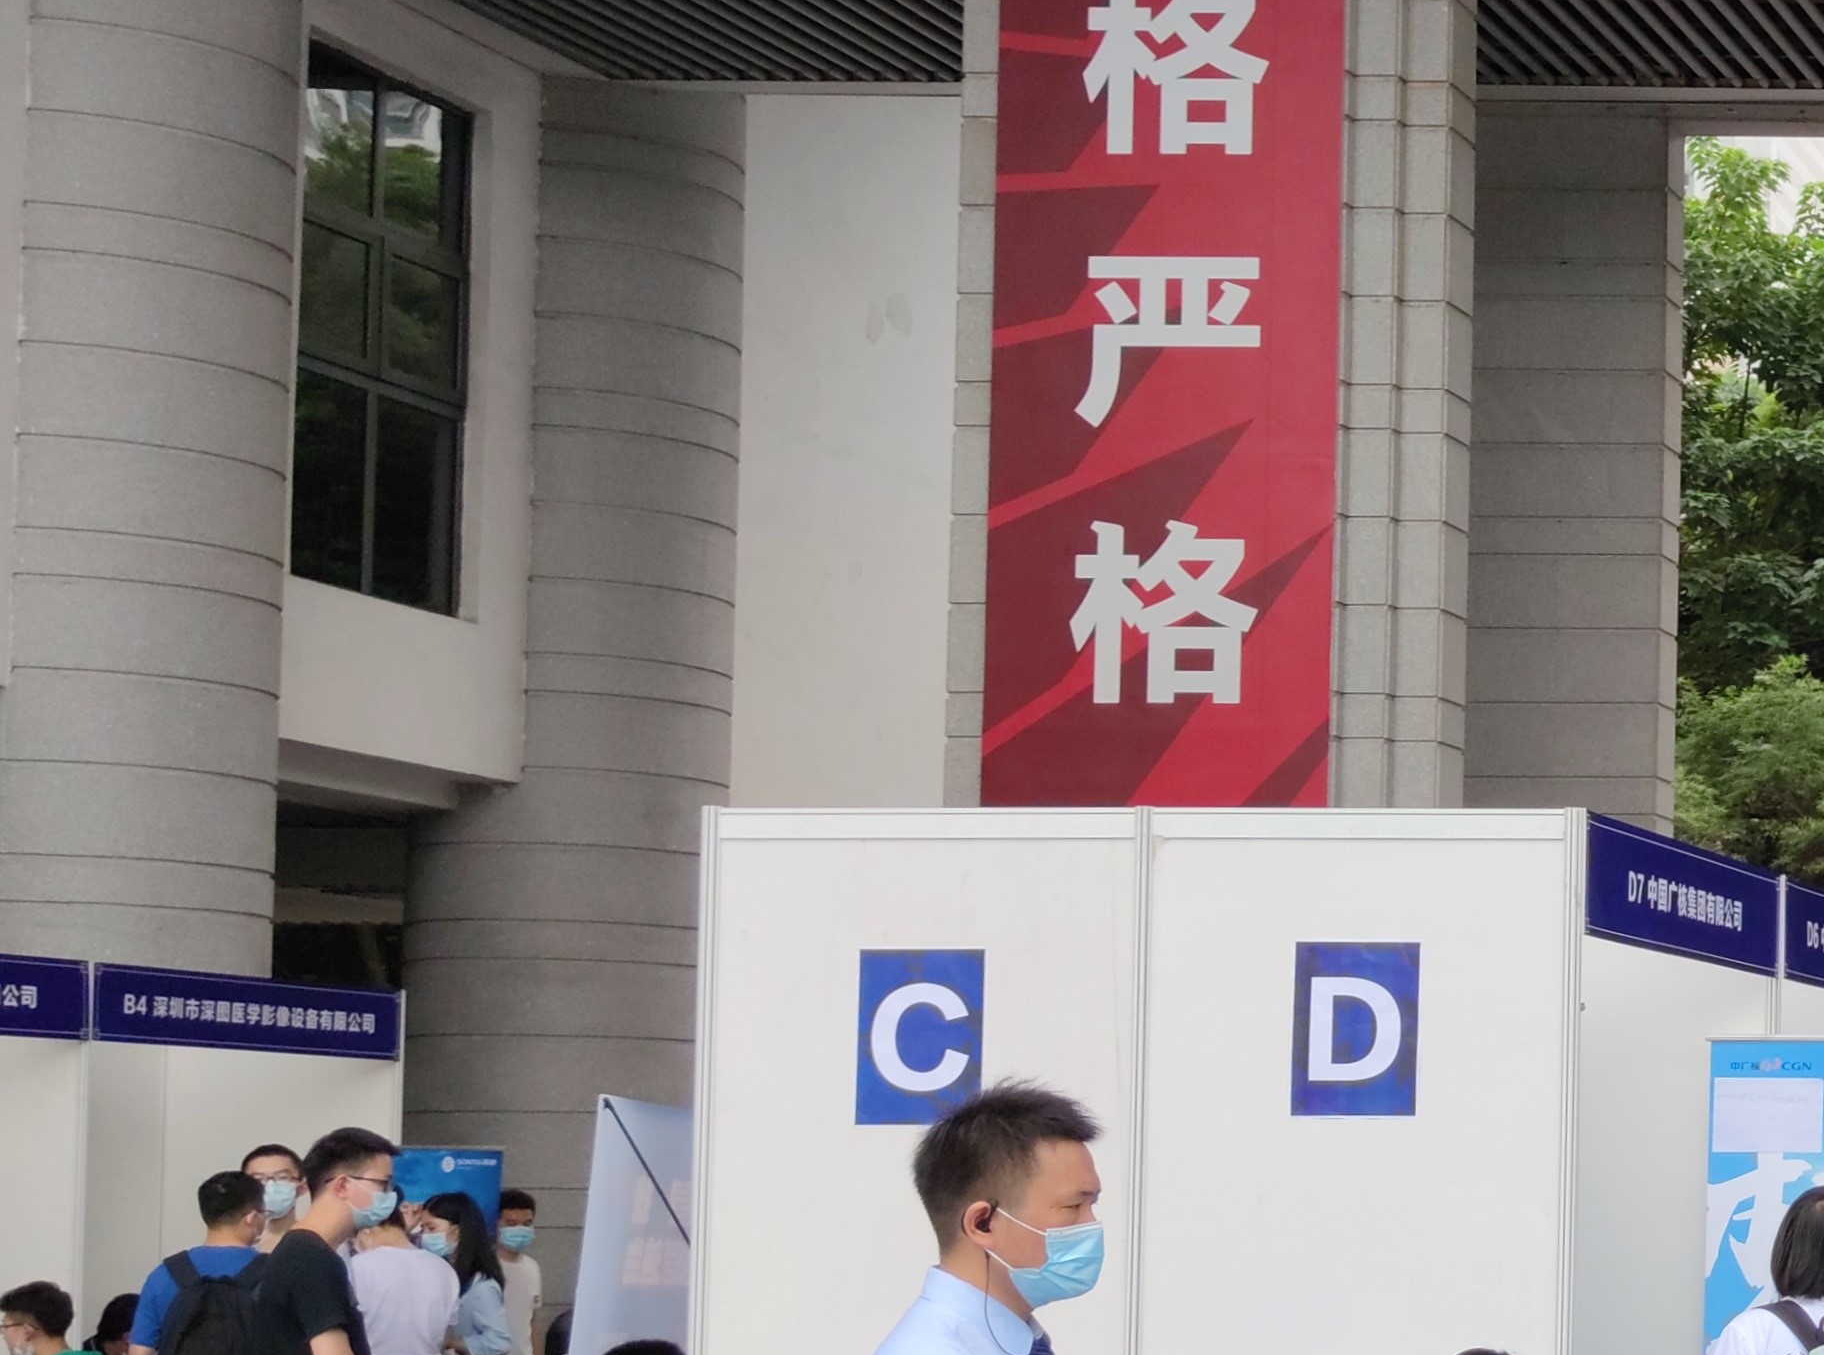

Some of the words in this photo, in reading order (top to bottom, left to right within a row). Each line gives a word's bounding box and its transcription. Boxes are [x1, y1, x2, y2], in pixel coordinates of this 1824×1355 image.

[1628, 871, 1645, 904] D7
[1647, 875, 1743, 932] 中国广核集团有限公司
[1806, 920, 1819, 949] D6
[0, 983, 38, 1010] 公司
[123, 993, 147, 1016] B4
[153, 995, 376, 1035] 深圳市深图医学影像设备有限公司
[870, 982, 970, 1092] C
[1307, 976, 1402, 1082] D
[1781, 1060, 1812, 1070] CGN
